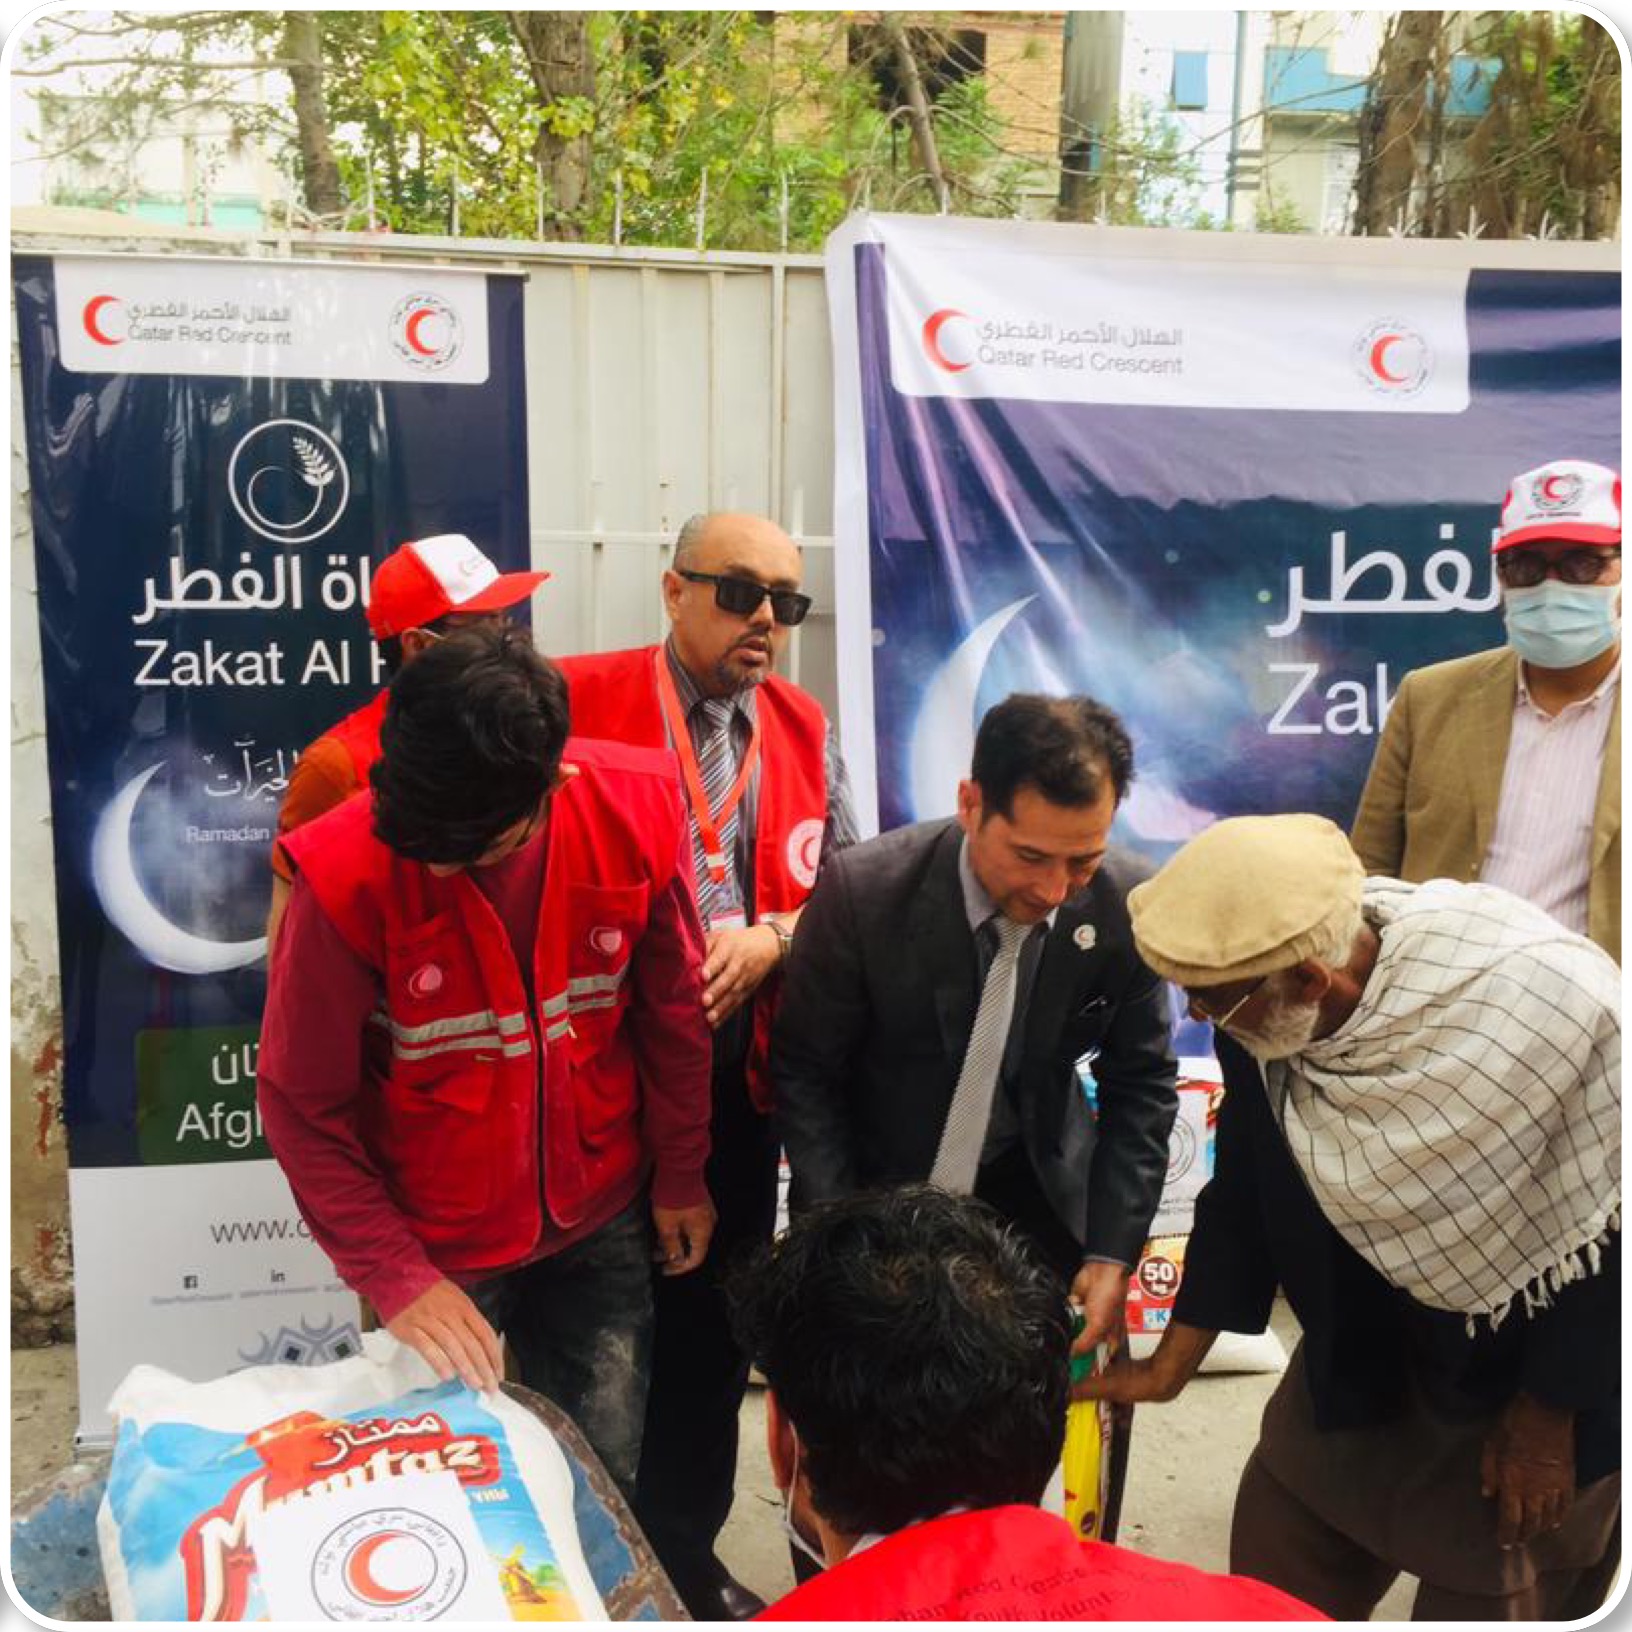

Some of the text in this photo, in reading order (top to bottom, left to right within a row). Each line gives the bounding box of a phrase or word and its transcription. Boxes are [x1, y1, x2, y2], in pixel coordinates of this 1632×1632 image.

[128, 325, 173, 344] Qatar
[977, 345, 1184, 375] Qatar Red Crescent
[132, 552, 303, 625] الفطر
[1266, 522, 1501, 638] لفطر
[133, 640, 284, 687] Zakat
[301, 640, 350, 685] Al
[186, 825, 270, 843] Ramadan
[1144, 1263, 1174, 1281] 50
[312, 1412, 441, 1470] ممتاز
